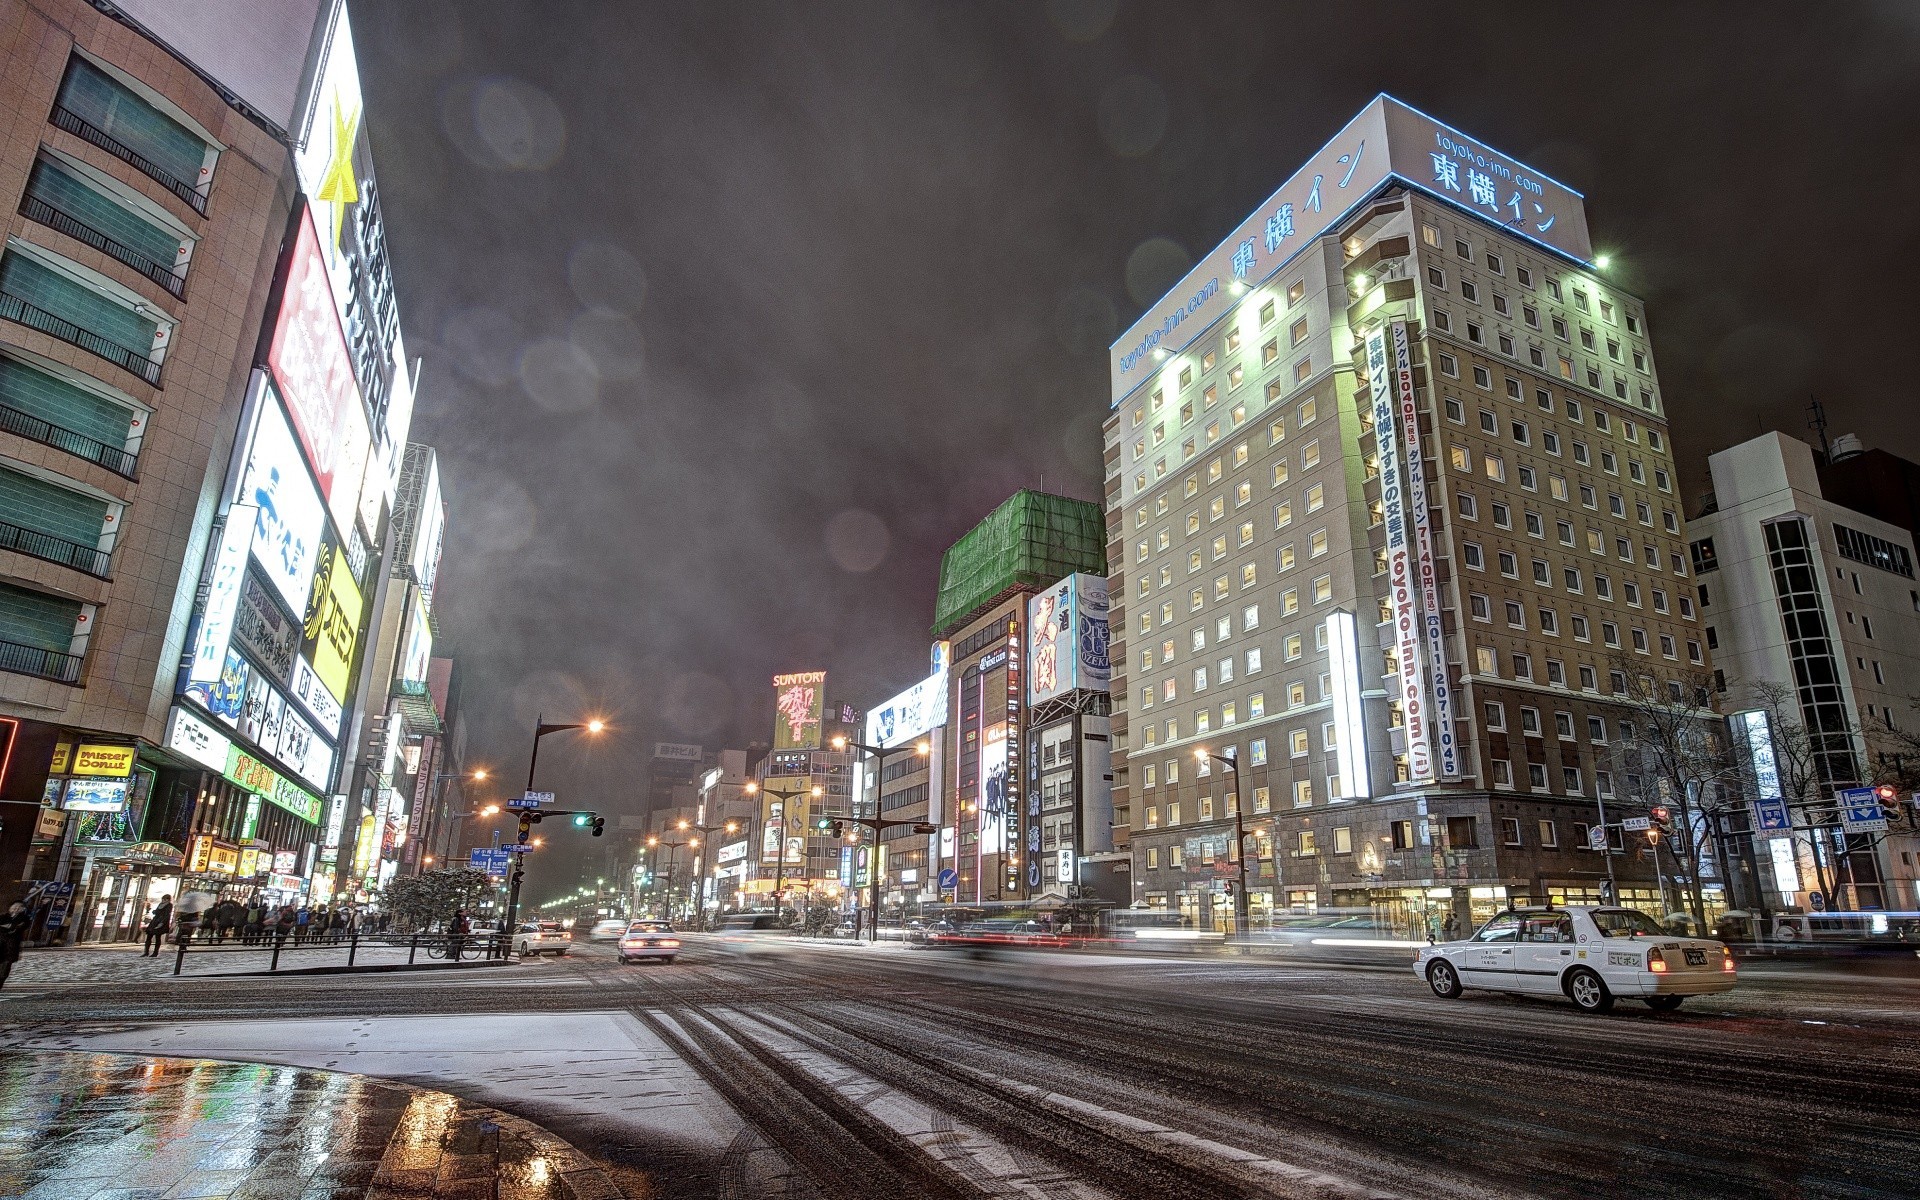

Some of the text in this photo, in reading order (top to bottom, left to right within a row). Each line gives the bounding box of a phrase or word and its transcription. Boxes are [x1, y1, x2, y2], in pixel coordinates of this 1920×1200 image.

[1430, 152, 1556, 232] 東横イン
[1436, 131, 1544, 197] toyoko-inn.com
[1230, 139, 1366, 282] 東横イン
[1120, 278, 1219, 374] toyoko-inn.com
[1368, 334, 1404, 549] 東横イン札幌すすきの交差点
[322, 588, 355, 670] プロミス
[1034, 595, 1058, 694] 大関
[1058, 585, 1070, 632] 清酒
[773, 671, 827, 687] SUNTORY
[1081, 652, 1109, 667] OZEKI
[78, 760, 126, 770] Donut
